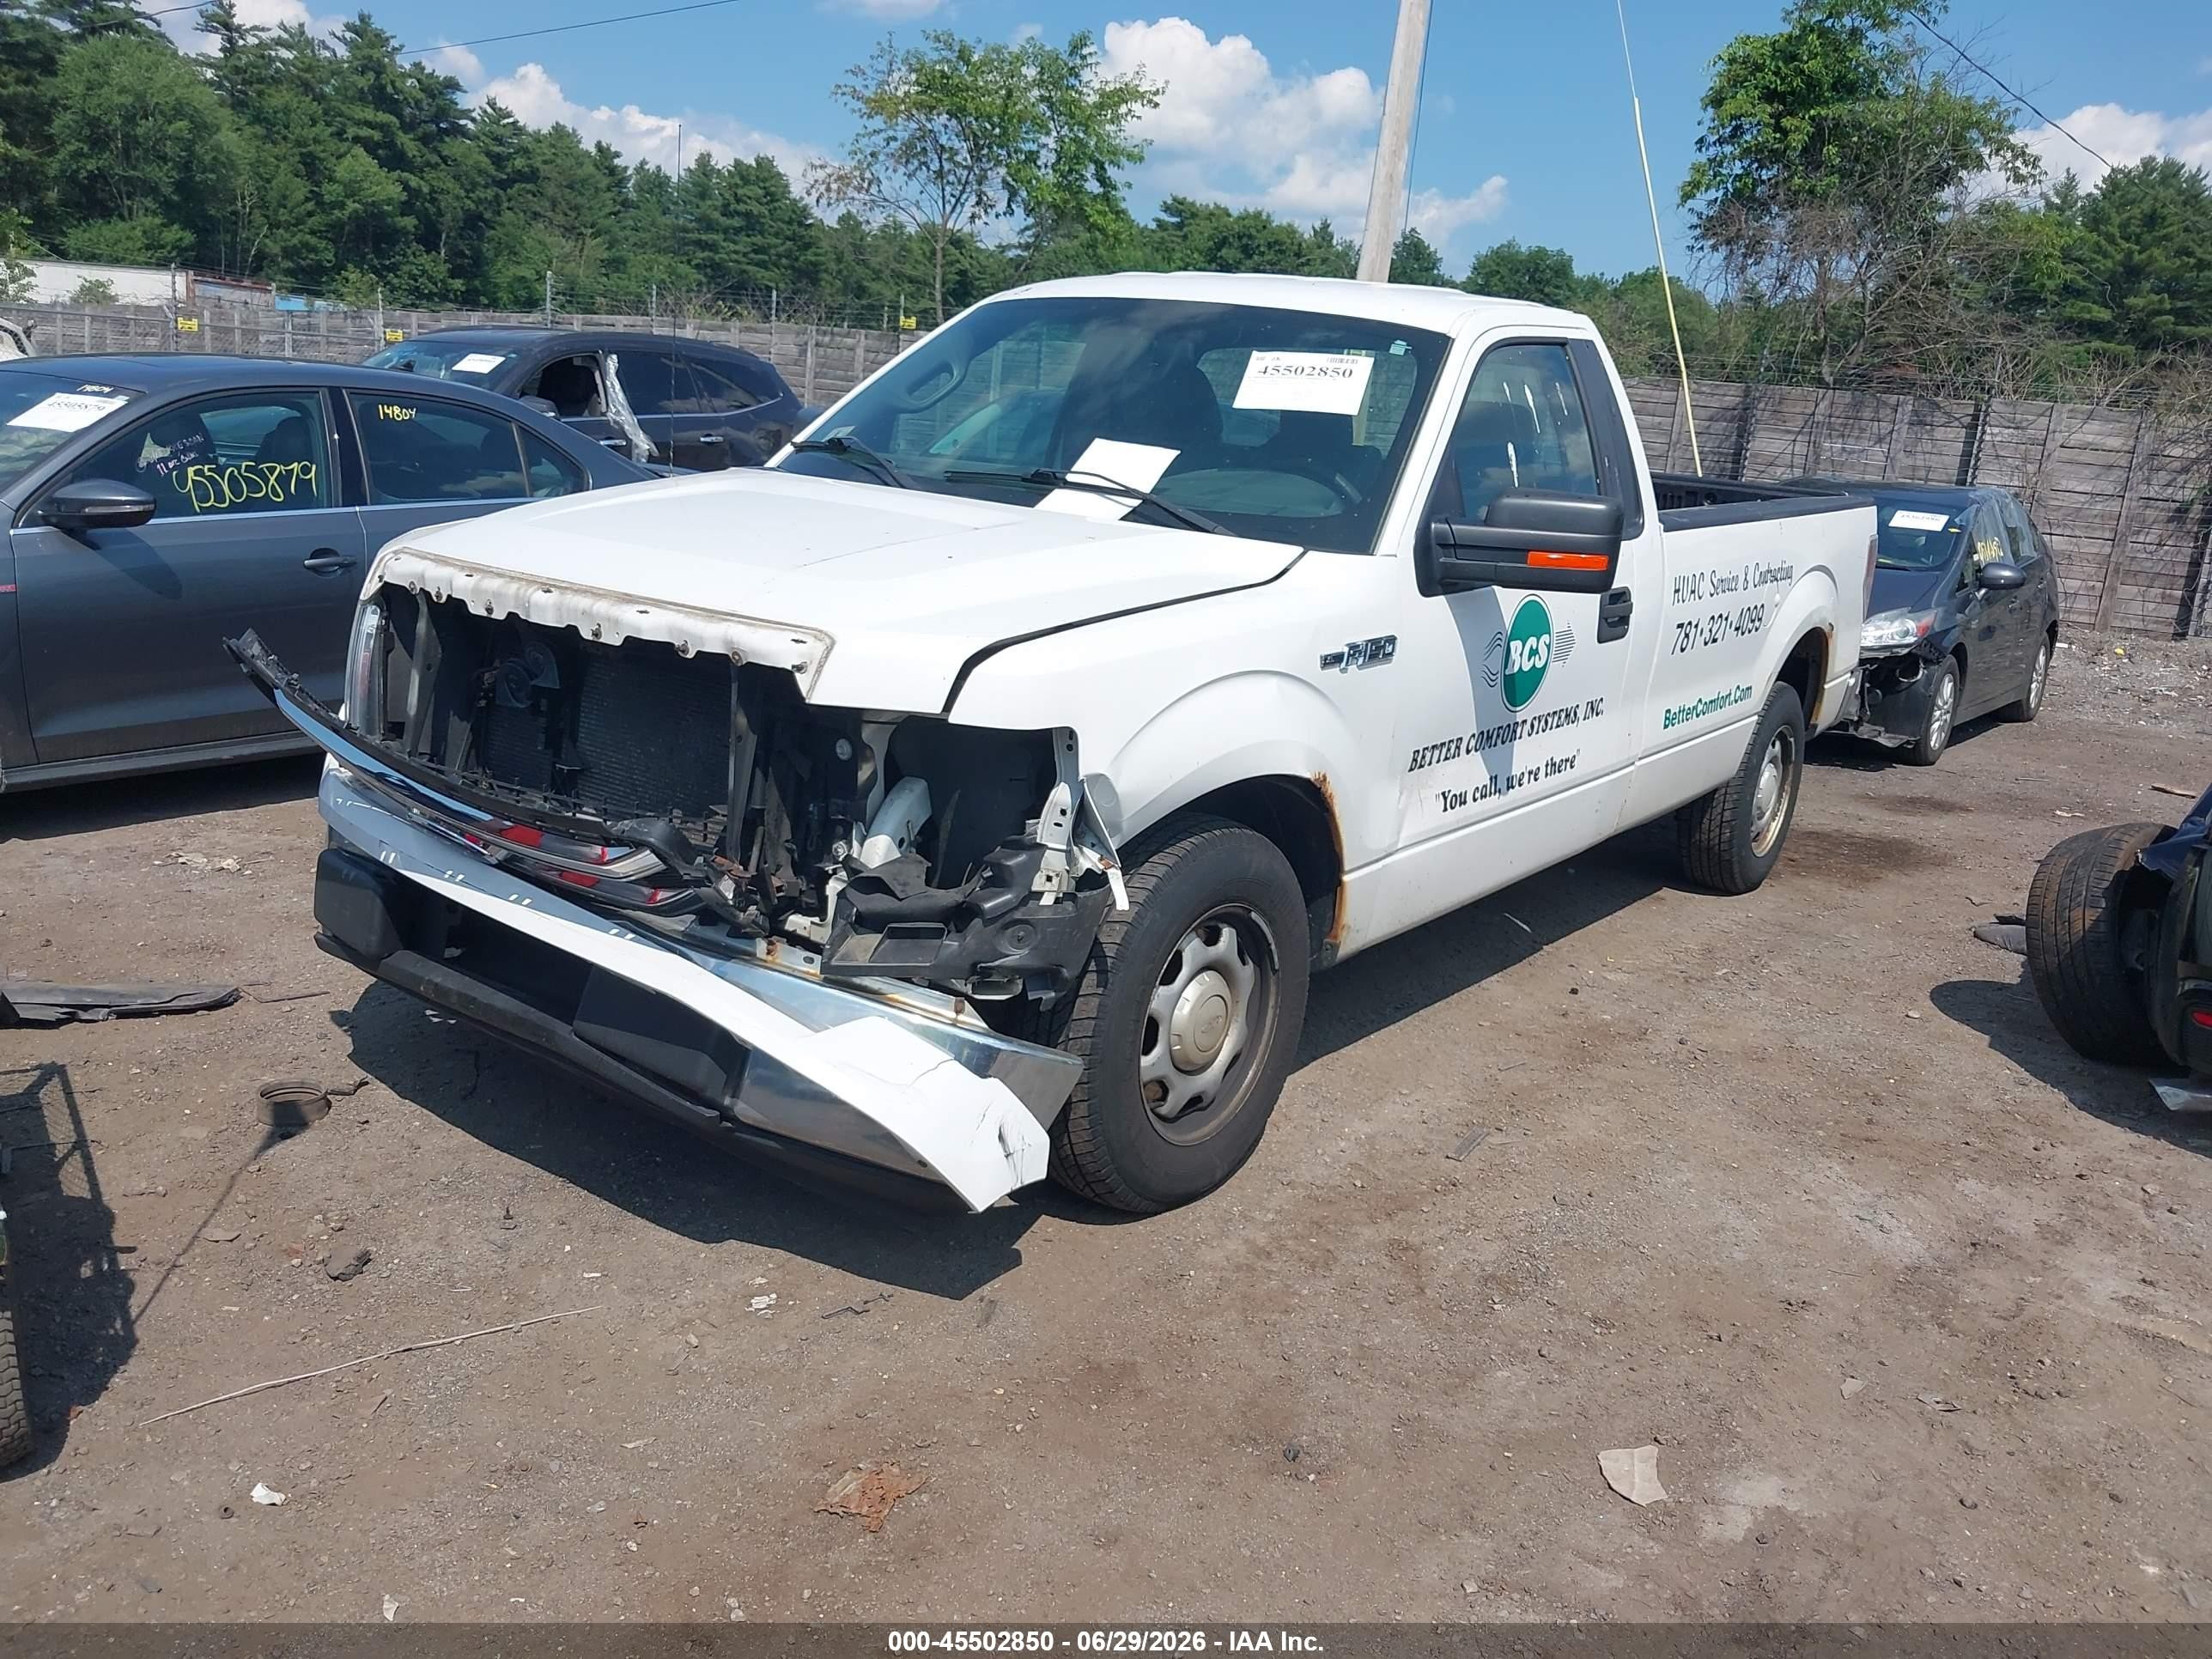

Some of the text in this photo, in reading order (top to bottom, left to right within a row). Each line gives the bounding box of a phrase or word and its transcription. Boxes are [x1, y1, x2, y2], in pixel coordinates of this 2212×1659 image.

[1258, 365, 1353, 379] 45502850
[378, 404, 417, 421] 14804
[173, 461, 318, 513] 45505879
[1709, 569, 1740, 598] Service
[1742, 565, 1749, 591] &
[1753, 560, 1794, 589] Contracting
[1504, 634, 1550, 675] BCS
[1663, 684, 1753, 730] BetterComfort.Com
[1408, 697, 1604, 772] BETTER COMFORT SYSTEMS, INC.
[1435, 748, 1581, 812] "You call, we're there"
